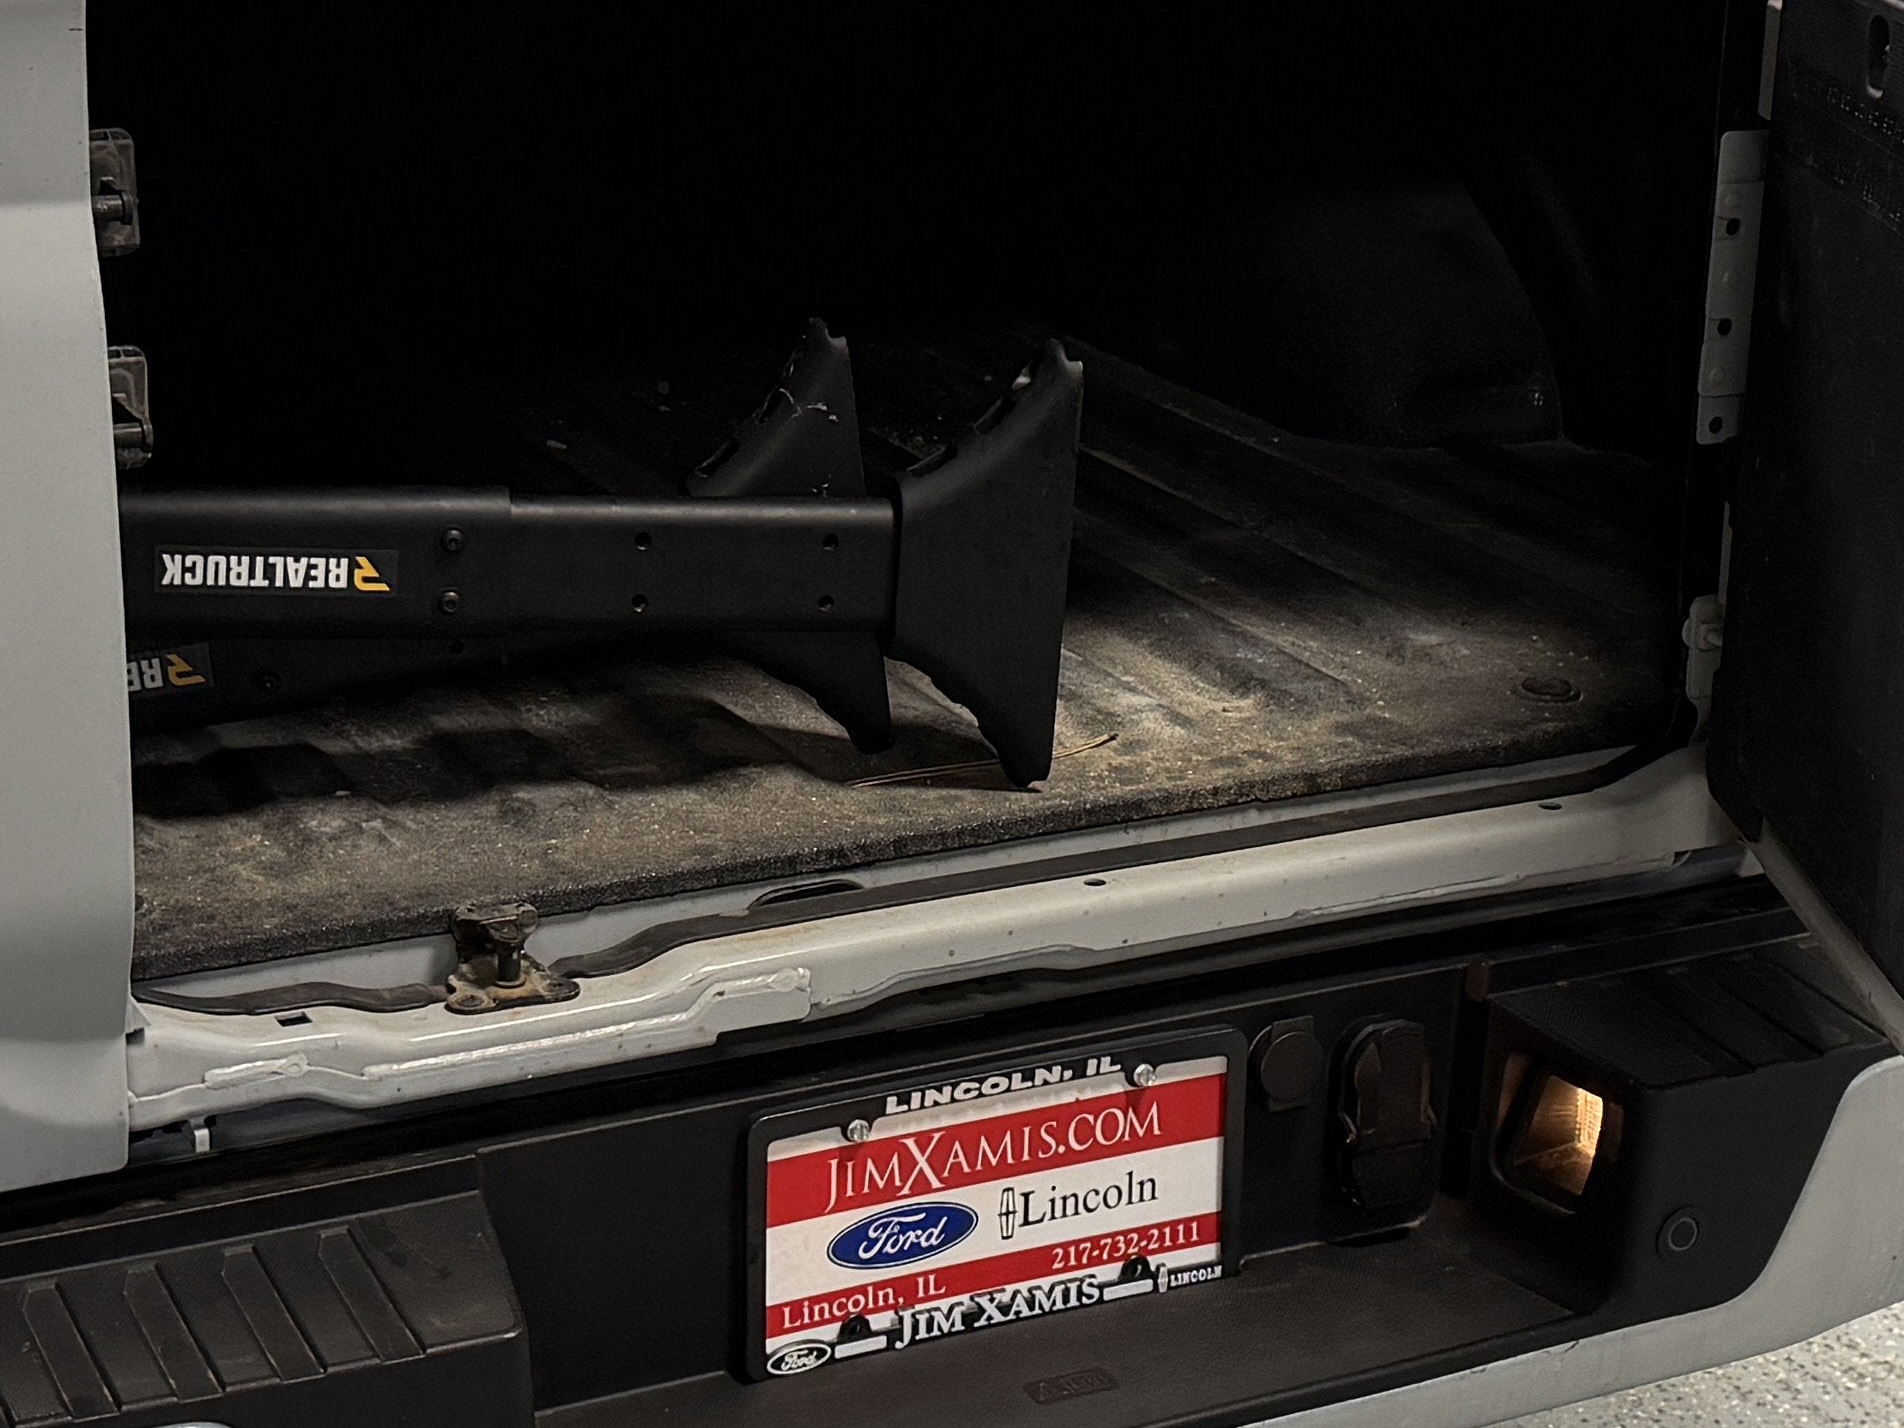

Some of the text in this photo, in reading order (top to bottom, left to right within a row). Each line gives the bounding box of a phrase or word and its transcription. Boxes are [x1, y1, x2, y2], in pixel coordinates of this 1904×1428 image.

[161, 553, 348, 589] REALTRUCK
[884, 1056, 1121, 1115] LINCOLN, IL
[1018, 1170, 1158, 1228] Lincoln
[856, 1212, 946, 1261] Ford
[1051, 1221, 1201, 1271] 217-732-2111
[1170, 1264, 1223, 1287] LINCOLN
[783, 1272, 946, 1330] Lincoln, IL
[895, 1277, 1100, 1350] JIM XAMIS
[780, 1349, 818, 1371] Ford
